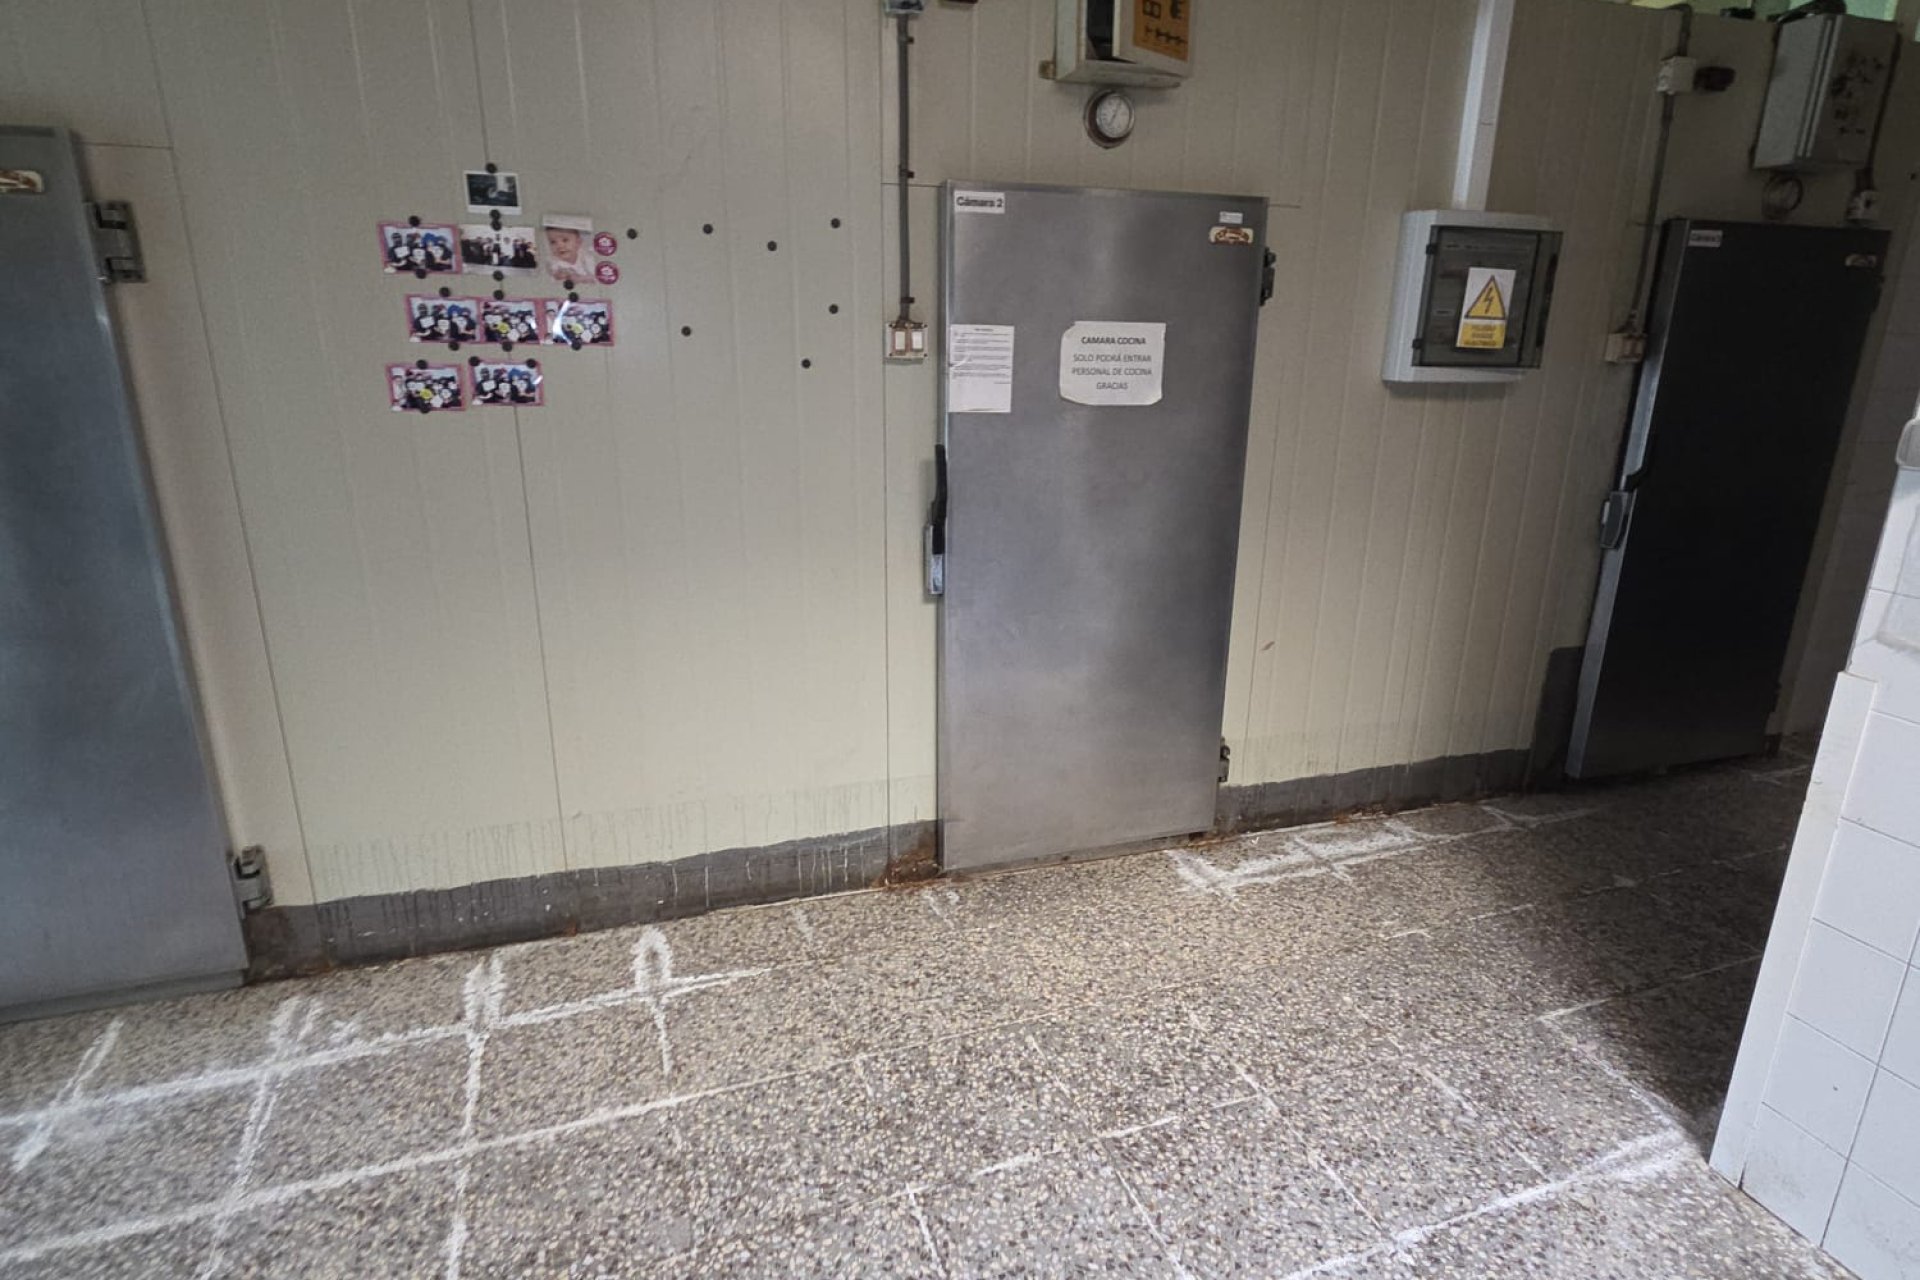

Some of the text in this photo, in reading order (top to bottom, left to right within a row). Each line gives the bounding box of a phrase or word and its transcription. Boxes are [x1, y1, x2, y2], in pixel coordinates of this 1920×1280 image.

[1080, 336, 1147, 345] CAMARA COCINA
[1073, 353, 1094, 362] SOLO
[1123, 354, 1152, 362] ENTRAR
[1071, 367, 1152, 376] PERSONAL DE COCINA
[1096, 382, 1129, 390] GRACIAS
